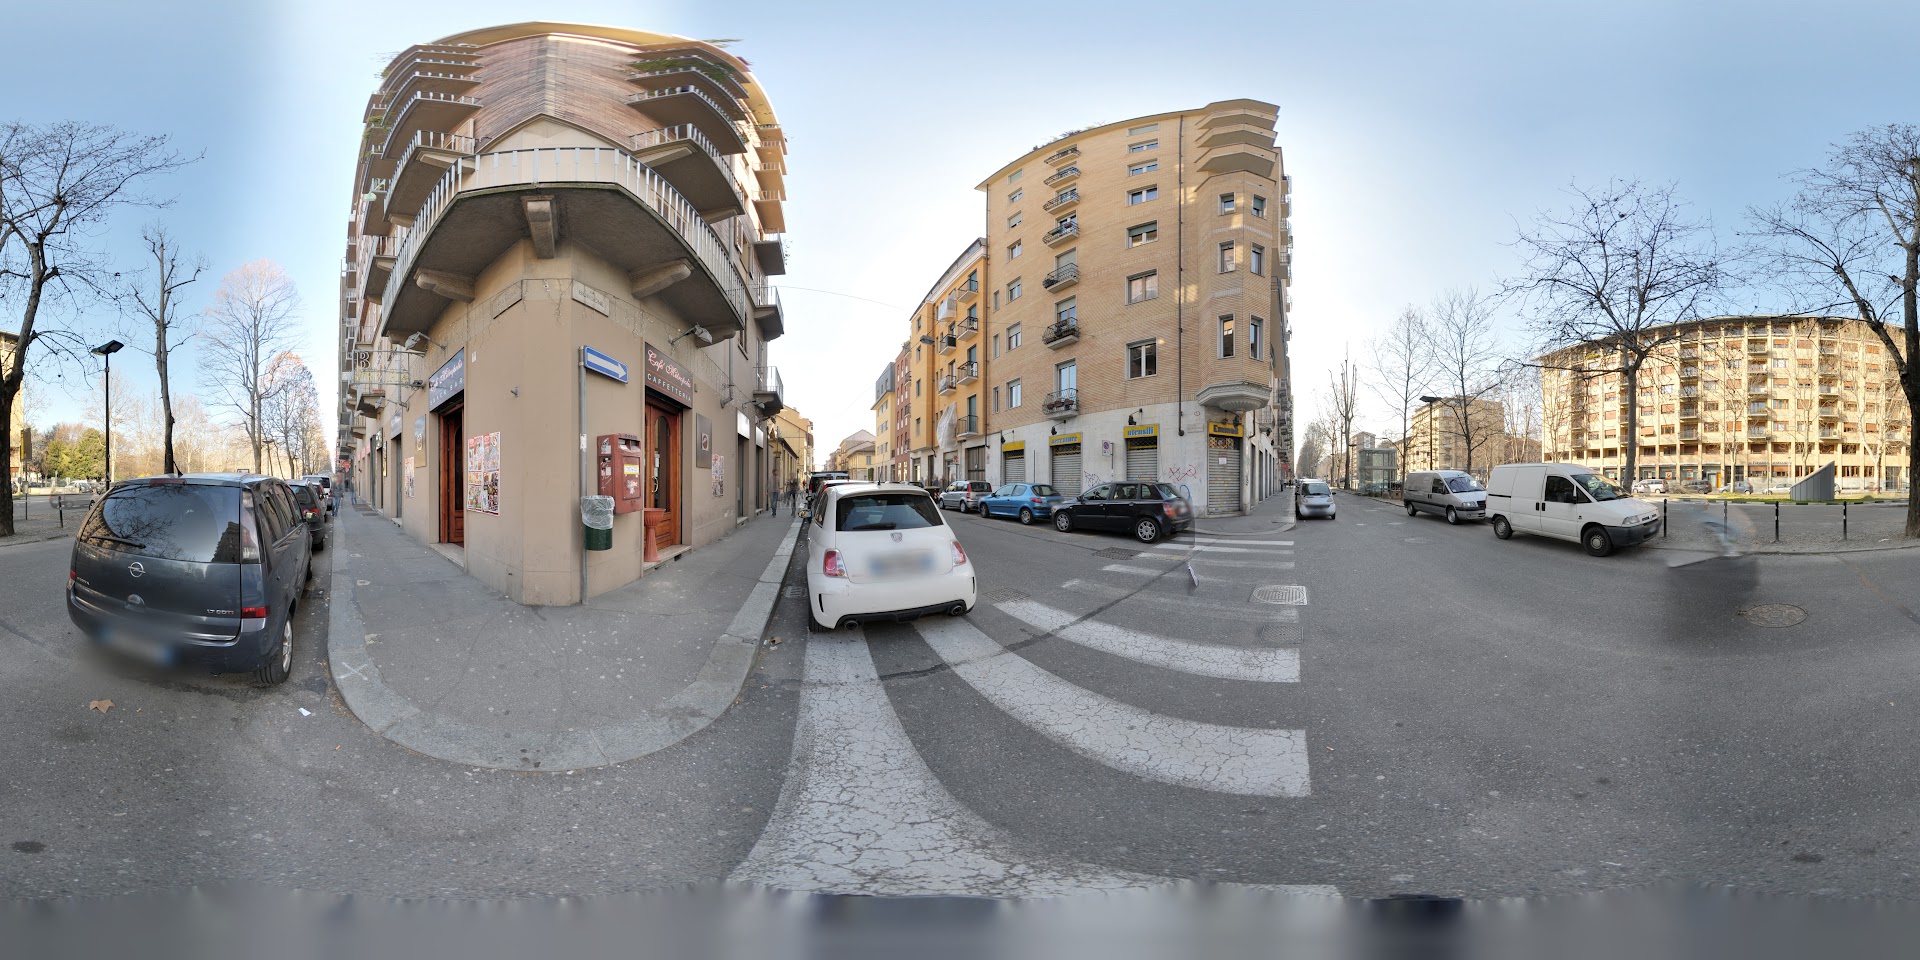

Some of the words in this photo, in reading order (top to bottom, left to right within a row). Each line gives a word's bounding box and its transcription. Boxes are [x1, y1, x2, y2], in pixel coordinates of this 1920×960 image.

[450, 377, 463, 391] BAR
[647, 373, 692, 401] CAFFETTERIA
[1127, 427, 1154, 436] utensili
